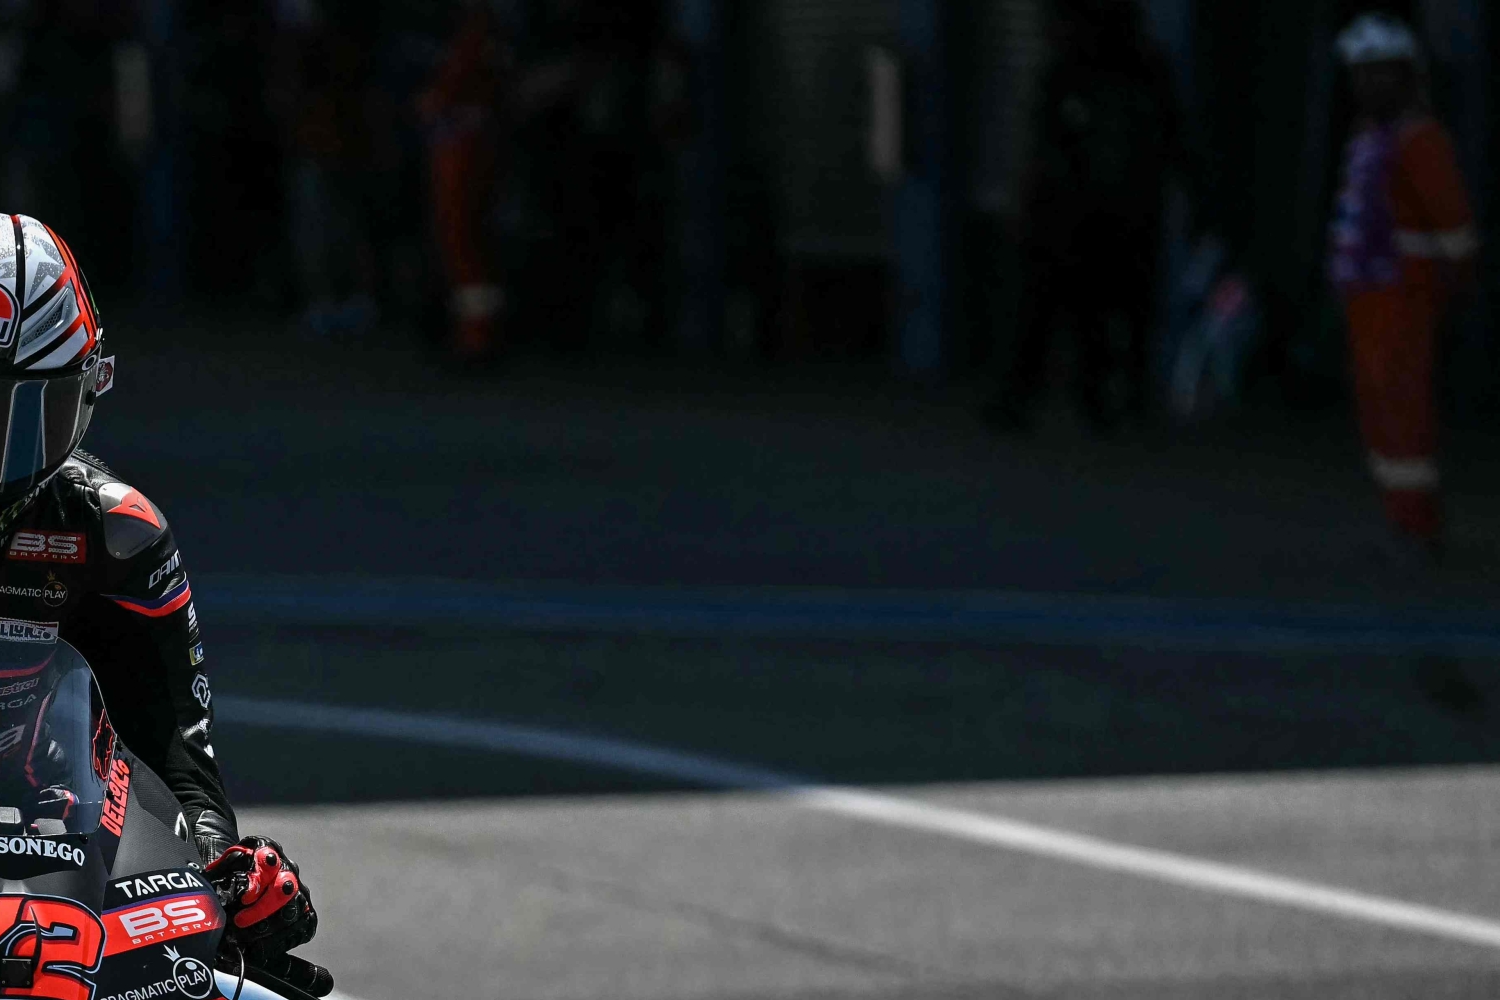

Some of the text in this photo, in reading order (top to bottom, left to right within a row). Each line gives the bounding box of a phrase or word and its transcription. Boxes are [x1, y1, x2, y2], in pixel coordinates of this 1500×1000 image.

[10, 532, 78, 554] BS
[8, 551, 79, 560] BATTERY
[44, 589, 67, 599] PLAY
[115, 871, 203, 899] TARGA
[118, 899, 206, 938] BS
[132, 920, 212, 945] BATTERY
[178, 968, 209, 989] PLAY
